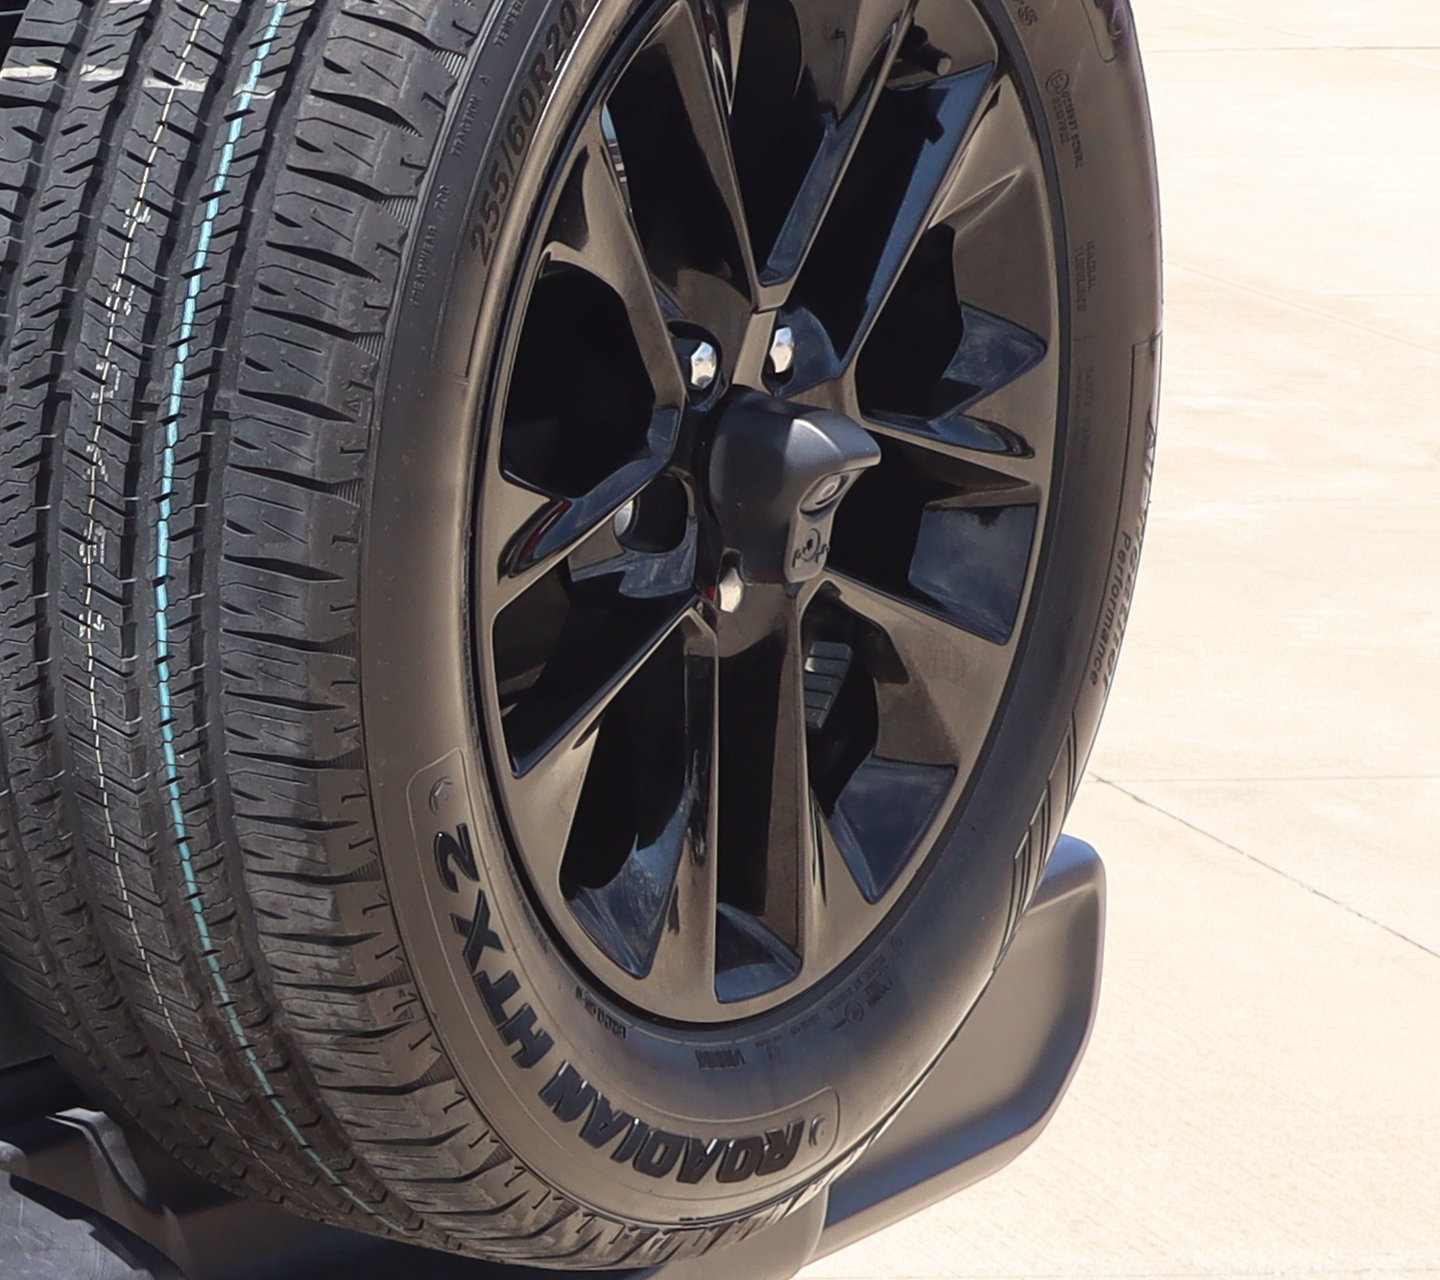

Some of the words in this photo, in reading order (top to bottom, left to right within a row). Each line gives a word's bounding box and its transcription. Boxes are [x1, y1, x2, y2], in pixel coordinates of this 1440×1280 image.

[434, 185, 452, 211] 700
[450, 96, 478, 158] TRACTION
[469, 0, 578, 268] 255/60R20
[1087, 529, 1131, 687] Performance
[538, 1060, 804, 1185] ROADIAN
